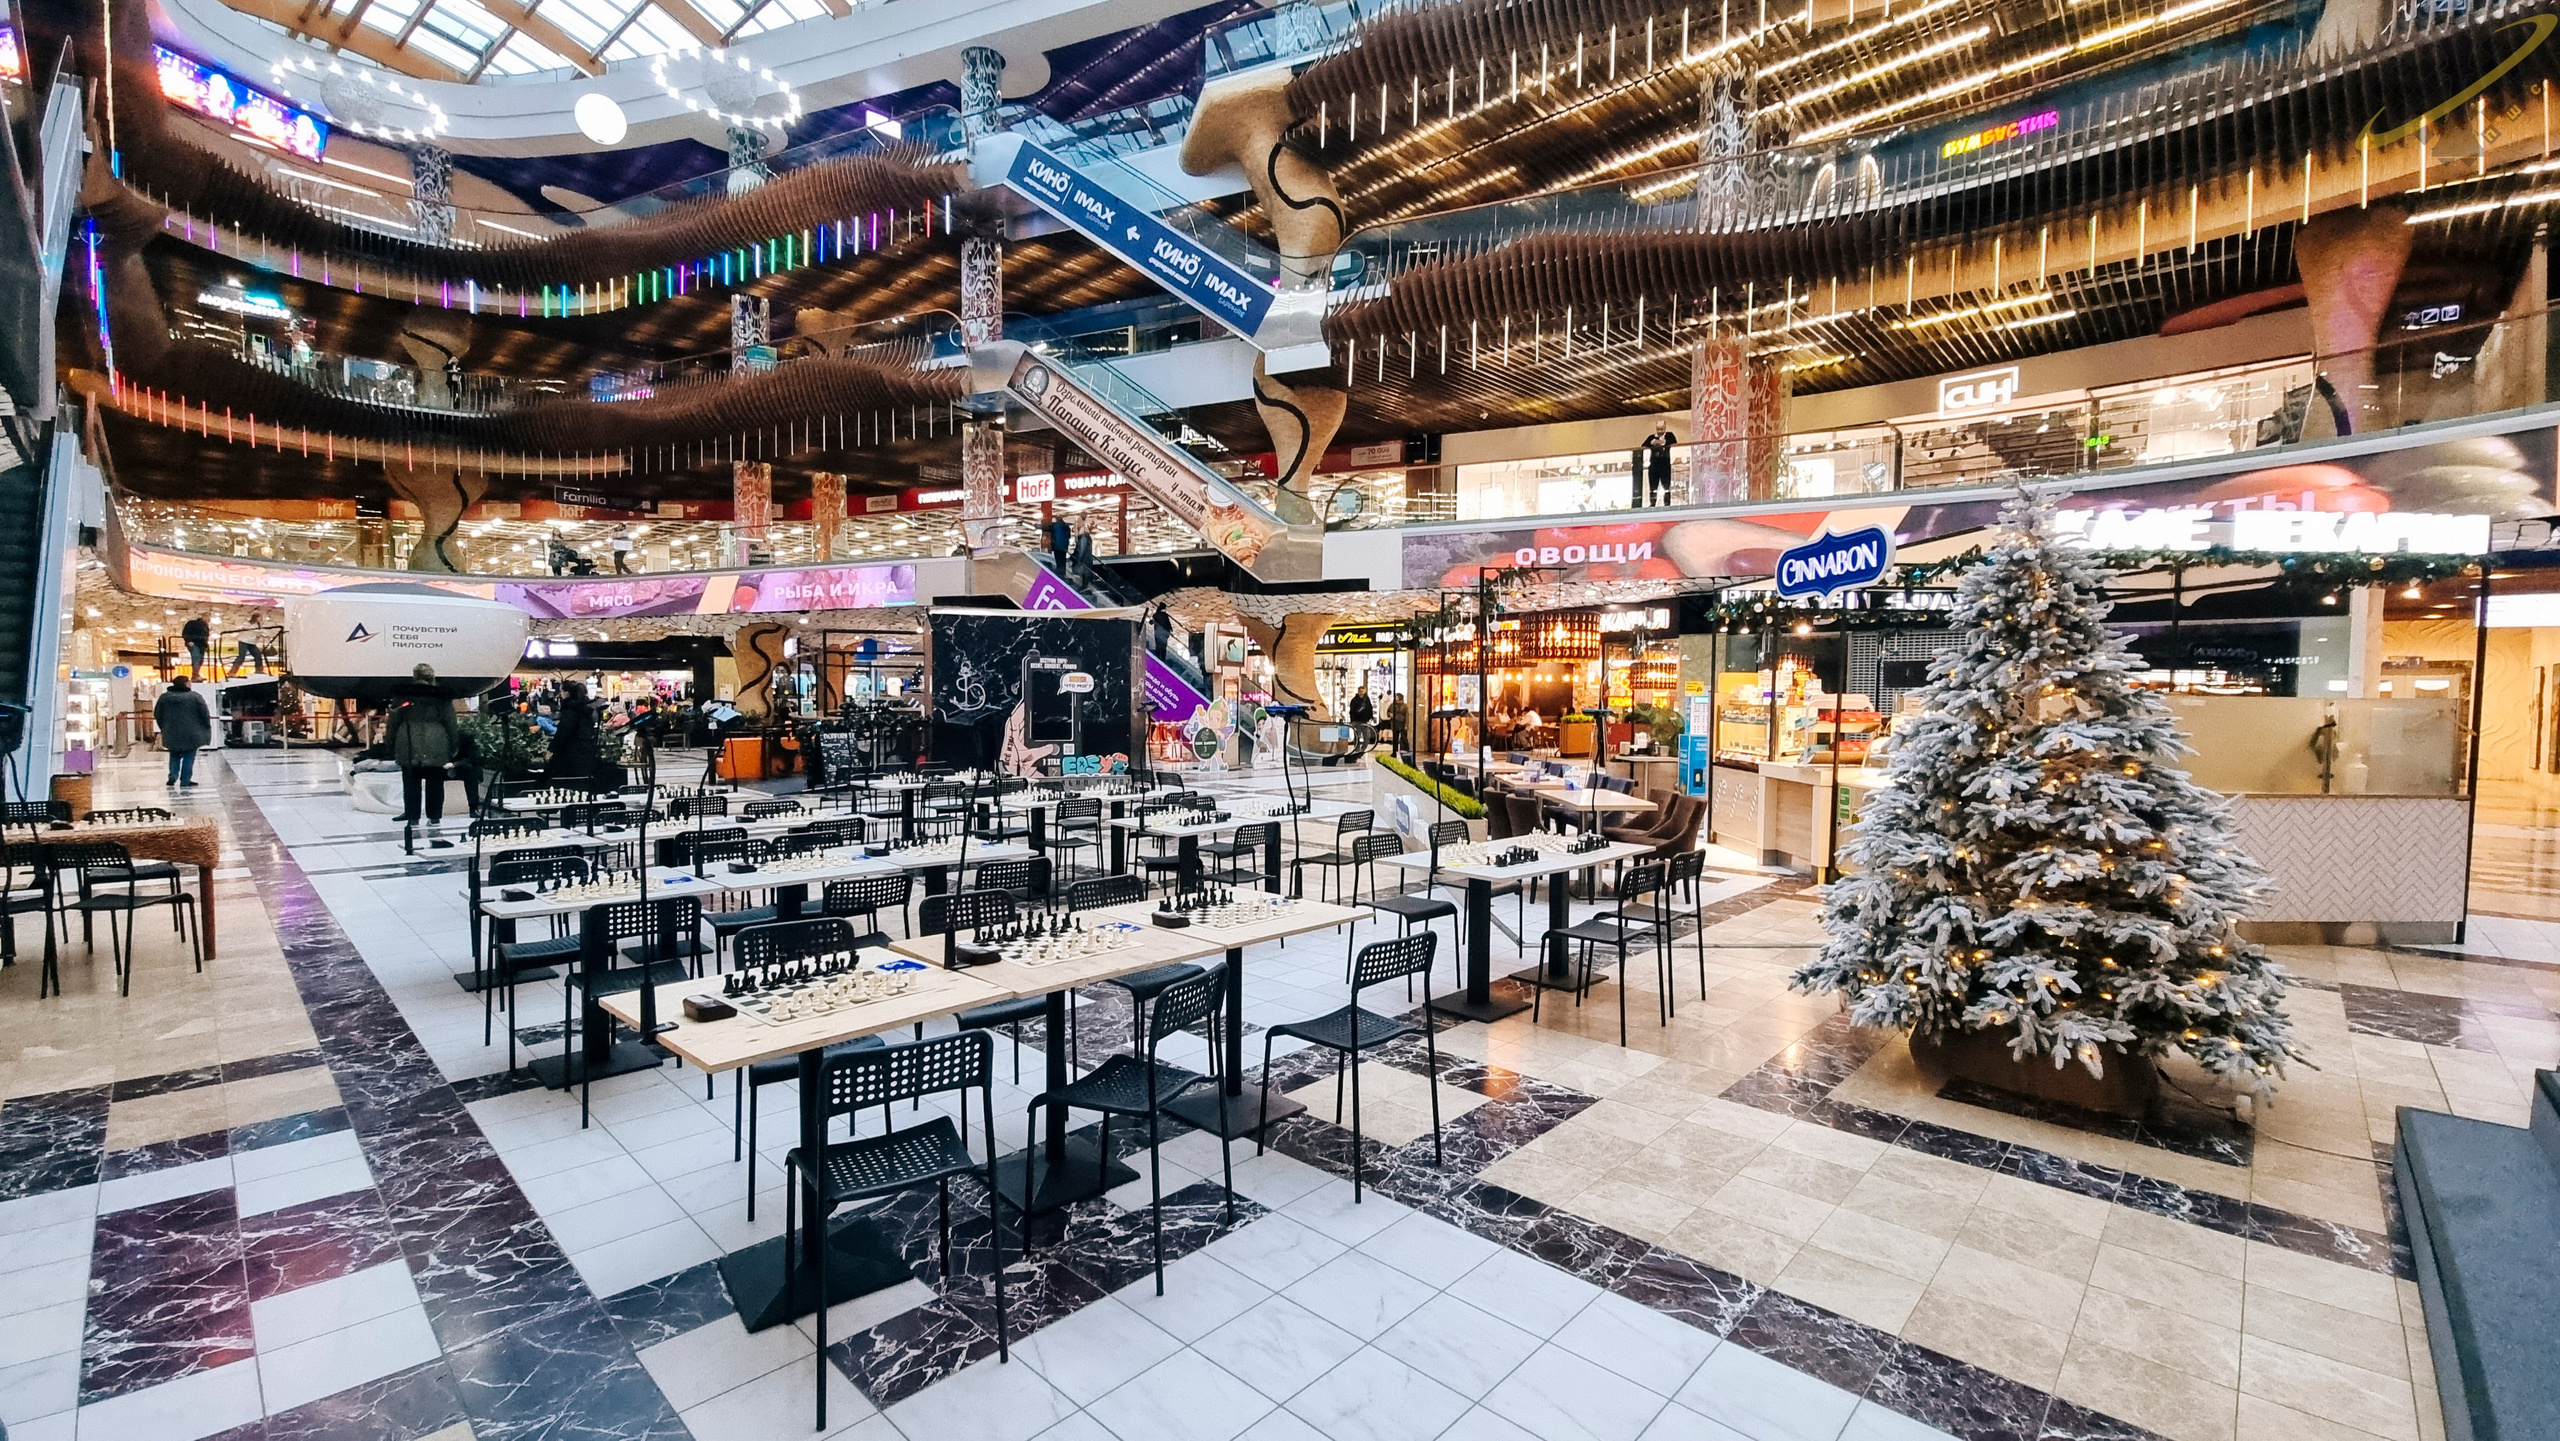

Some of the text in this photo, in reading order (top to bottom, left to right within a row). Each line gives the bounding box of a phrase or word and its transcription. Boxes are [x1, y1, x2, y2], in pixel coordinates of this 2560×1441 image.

[1943, 111, 2058, 158] БУМБАСТИК
[1074, 189, 1116, 224] IMAX
[1204, 272, 1252, 311] IMAX
[1047, 395, 1100, 443] Папаша
[1099, 434, 1147, 478] Клаусс
[1056, 380, 1101, 422] Огромный
[1100, 415, 1132, 444] пивной
[1130, 438, 1178, 479] ресторан
[1021, 479, 1051, 498] Hoff
[1064, 477, 1106, 490] ТОВАРЫ
[562, 492, 608, 505] familia
[1175, 490, 1206, 515] этаж
[317, 502, 343, 517] Hoff
[1515, 541, 1652, 565] ОВОЩИ
[1782, 540, 1878, 587] CINNABON
[774, 580, 899, 599] РЫБА И ИКРА
[589, 594, 633, 608] МЯСО
[392, 625, 458, 633] ПОЧУВСТВУЙ
[392, 633, 419, 641] СЕБЯ
